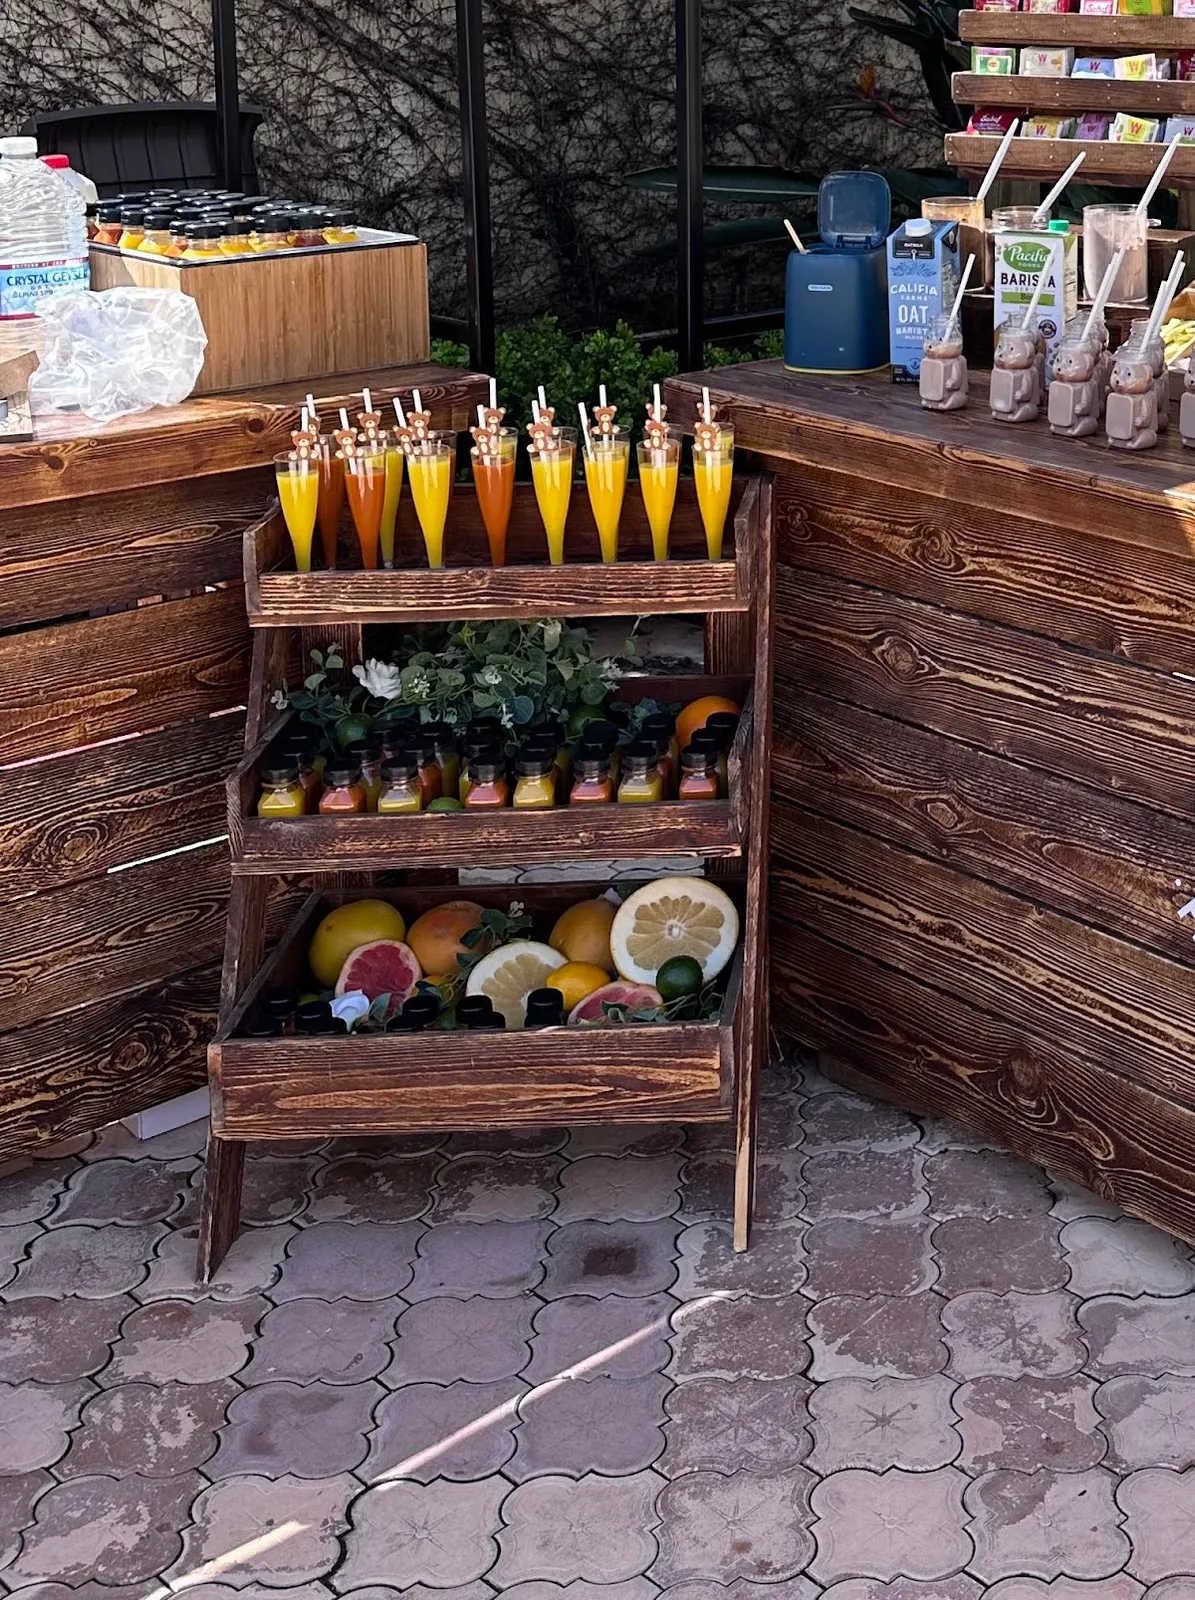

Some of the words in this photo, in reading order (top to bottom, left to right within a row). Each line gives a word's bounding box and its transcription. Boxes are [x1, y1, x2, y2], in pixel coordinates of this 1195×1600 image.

[1089, 61, 1101, 71] W
[1128, 61, 1141, 73] W
[1036, 124, 1047, 135] W
[1130, 121, 1143, 135] W
[1184, 126, 1194, 136] W
[7, 273, 50, 286] CRYSTAL
[1001, 272, 1056, 288] BARISA
[890, 283, 938, 296] CALIFIA
[898, 304, 929, 324] OAT
[895, 327, 931, 336] BARIST
